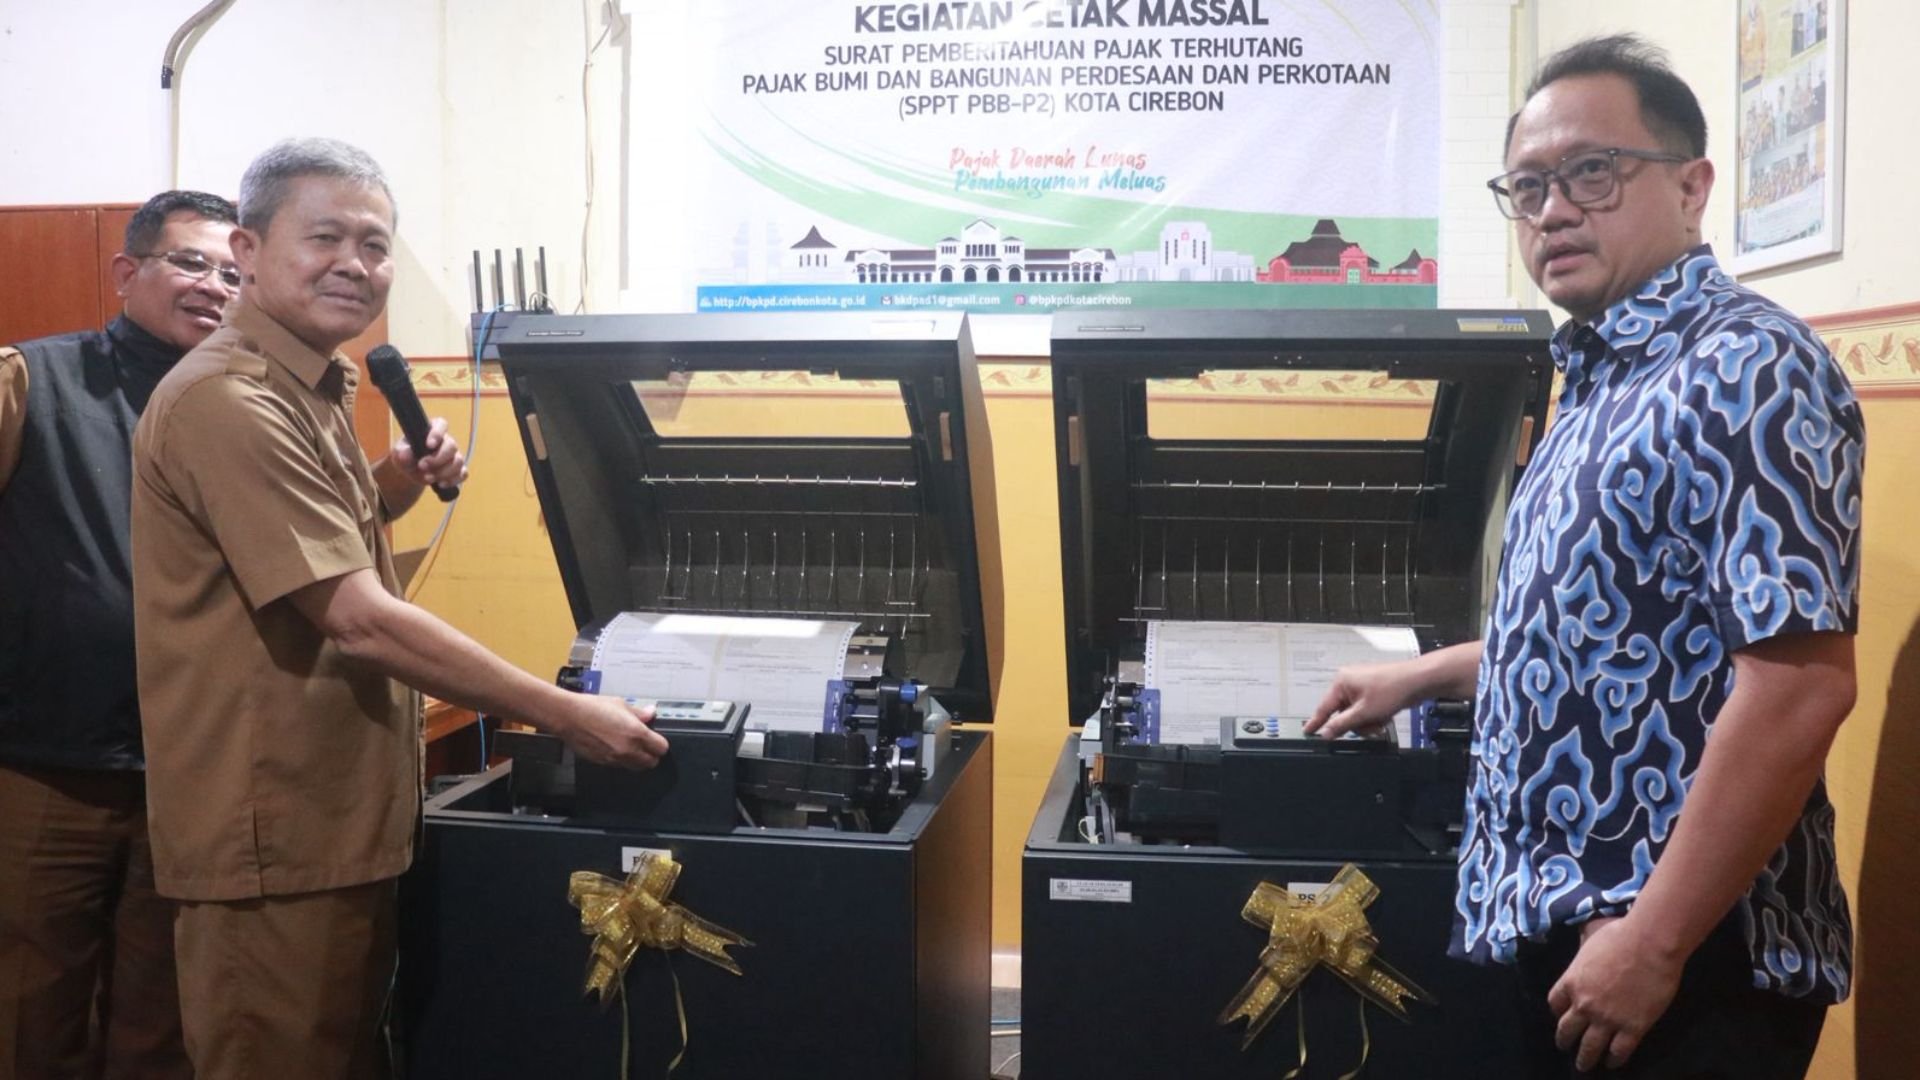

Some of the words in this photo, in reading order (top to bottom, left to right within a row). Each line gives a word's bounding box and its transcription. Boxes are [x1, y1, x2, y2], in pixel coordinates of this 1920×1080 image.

[855, 2, 1013, 33] KEGIATAN
[1138, 0, 1269, 27] MASSAL
[824, 44, 894, 66] SURAT
[902, 40, 1085, 63] PEMBERITAHUAN
[1094, 38, 1162, 60] PAJAK
[1170, 36, 1303, 58] TERHUTANG
[742, 73, 807, 94] PAJAK
[815, 71, 868, 92] BUMI
[877, 70, 921, 90] DAN
[930, 67, 1051, 88] BANGUNAN
[1061, 65, 1194, 86] PERDESAAN
[1203, 64, 1249, 85] DAN
[1258, 63, 1391, 85] PERKOTAAN
[899, 95, 959, 121] (SPPT
[968, 93, 1056, 119] PBB-P2)
[1065, 92, 1121, 113] KOTA
[1128, 91, 1225, 112] CIREBON
[950, 147, 1000, 175] Pajak
[1009, 147, 1076, 169] Daerah
[1084, 145, 1148, 170] Lunas
[954, 169, 1090, 198] Pembangunan
[1099, 168, 1167, 192] Meluas
[713, 295, 866, 309] http://bpkpd.cirebonkota.go.id
